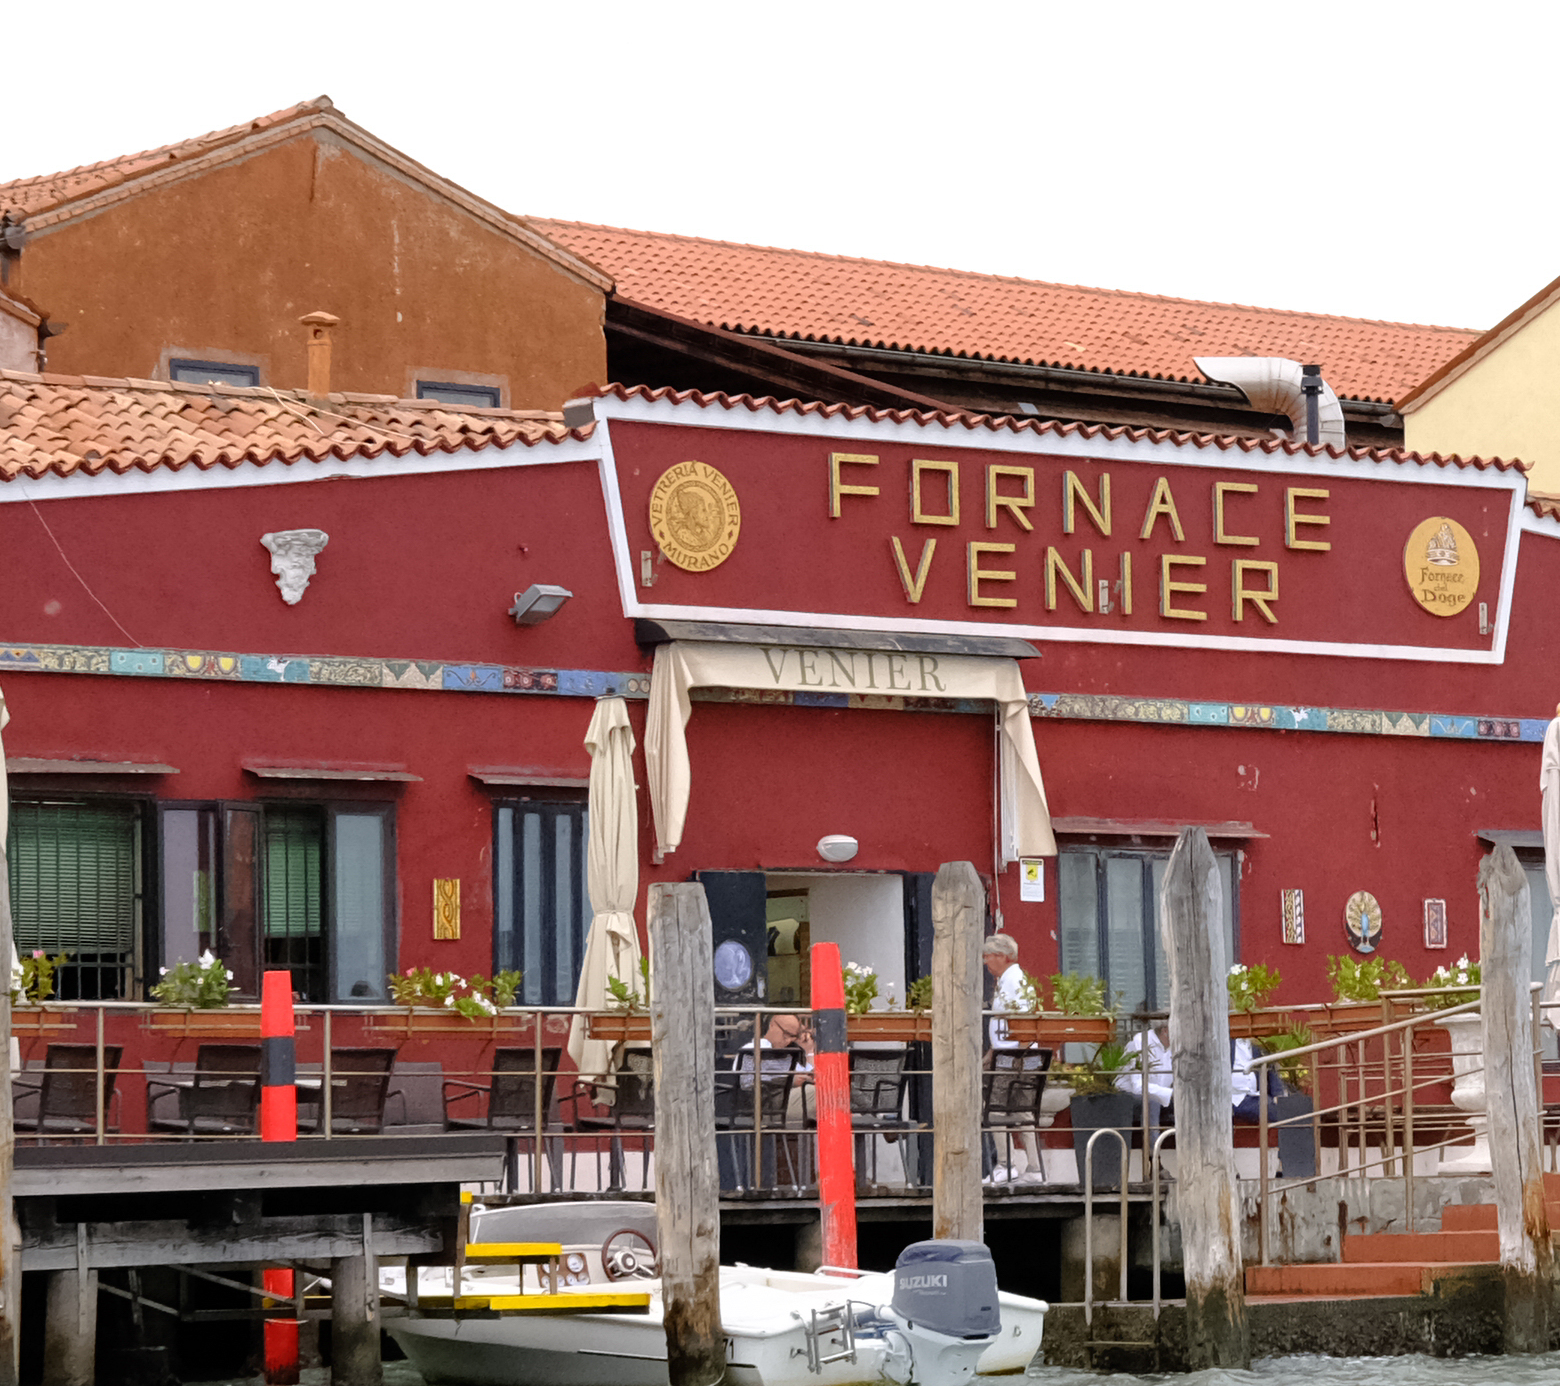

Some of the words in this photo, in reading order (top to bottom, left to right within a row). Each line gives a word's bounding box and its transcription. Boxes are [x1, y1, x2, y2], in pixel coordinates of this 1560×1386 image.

[651, 463, 699, 529] VETRERIA
[703, 466, 739, 526] VENIER
[828, 452, 1331, 551] FORNACE
[662, 541, 729, 569] MURANO
[891, 535, 1279, 624] VENIER
[1419, 566, 1465, 585] Fornace
[1421, 589, 1466, 607] Doge
[759, 647, 947, 692] VENIER
[900, 1274, 948, 1290] SUZUKI
